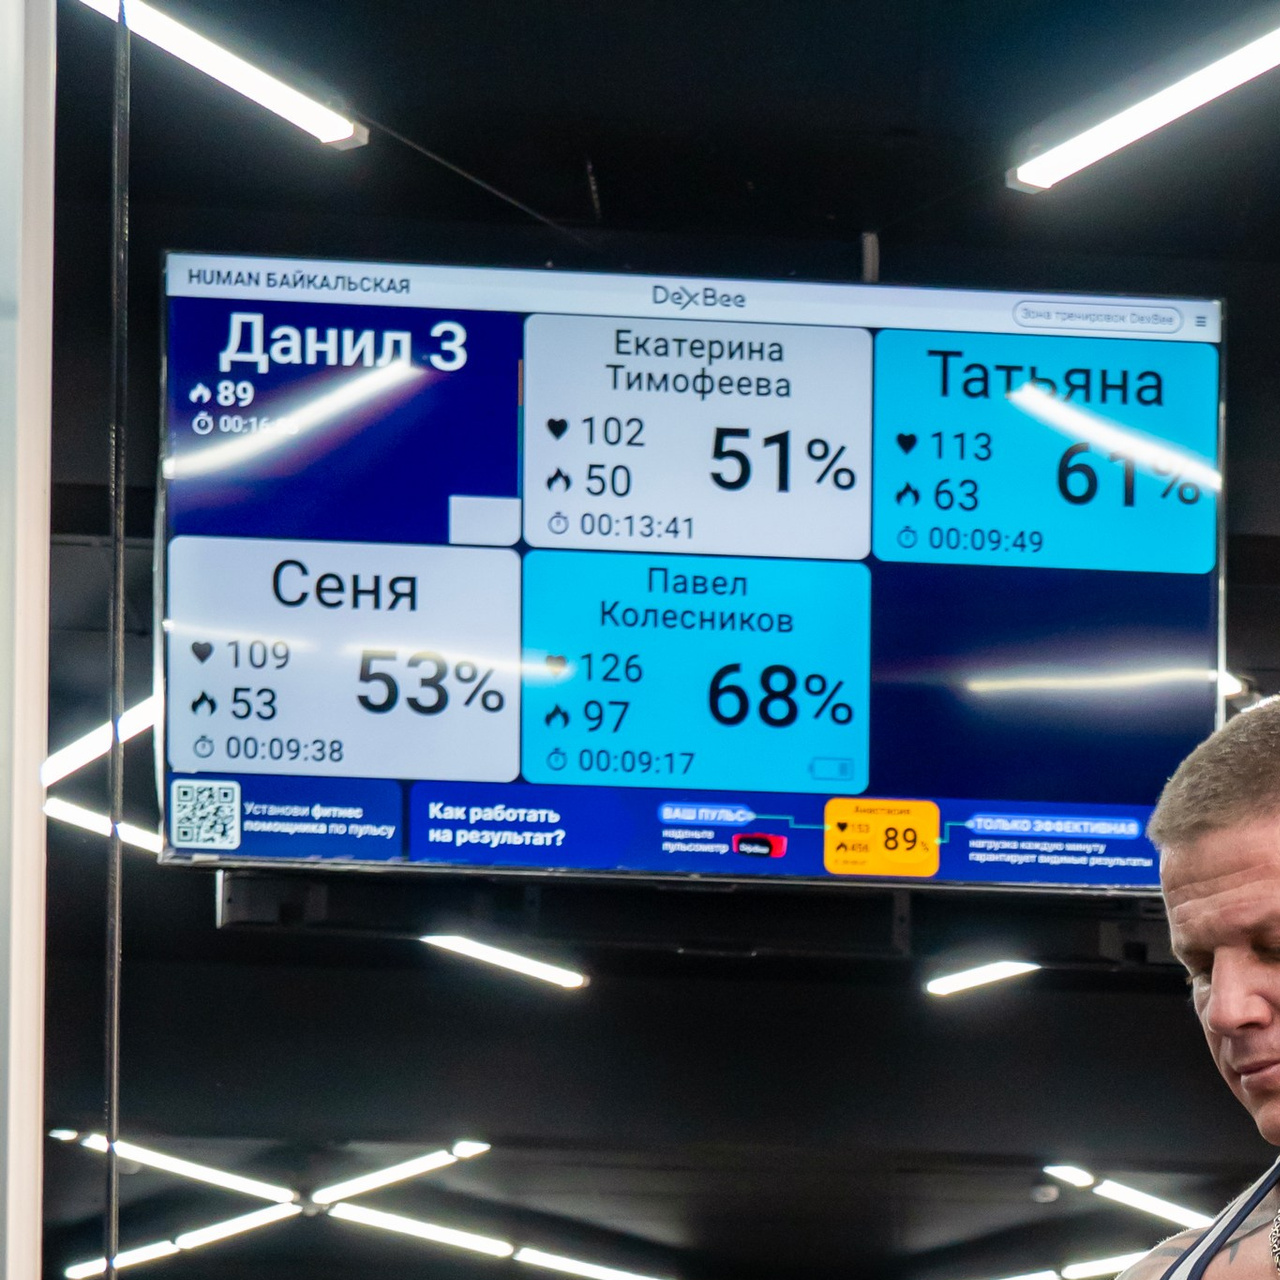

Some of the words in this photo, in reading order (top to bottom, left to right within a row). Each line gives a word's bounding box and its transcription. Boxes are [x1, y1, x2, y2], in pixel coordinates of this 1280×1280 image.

[188, 269, 260, 288] HUMAN
[266, 270, 411, 294] БАЙКАЛЬСКАЯ
[219, 312, 412, 374] Данил
[615, 329, 784, 366] Екатерина
[606, 364, 791, 401] Тимофеева
[927, 349, 1164, 406] Татьяна
[216, 380, 255, 408] 89
[581, 416, 647, 447] 102
[930, 431, 992, 462] 113
[709, 426, 856, 493] 51%
[585, 465, 632, 498] 50
[933, 479, 979, 511] 63
[580, 513, 695, 539] 00:13:41
[928, 527, 1043, 552] 00:09:49
[272, 559, 418, 612] Сеня
[647, 568, 748, 597] Павел
[600, 602, 794, 633] Колесников
[226, 640, 291, 669] 109
[580, 654, 643, 683] 126
[356, 649, 505, 716] 53%
[708, 663, 854, 727] 68%
[231, 687, 278, 721] 53
[583, 702, 630, 733] 97
[226, 736, 343, 762] 00:09:38
[579, 749, 695, 775] 00:09:17
[243, 802, 310, 817] Установи
[428, 802, 467, 820] Как
[469, 804, 561, 824] работать
[328, 823, 347, 835] по
[348, 824, 395, 839] пульсу
[428, 828, 453, 842] на
[455, 829, 566, 848] результат?
